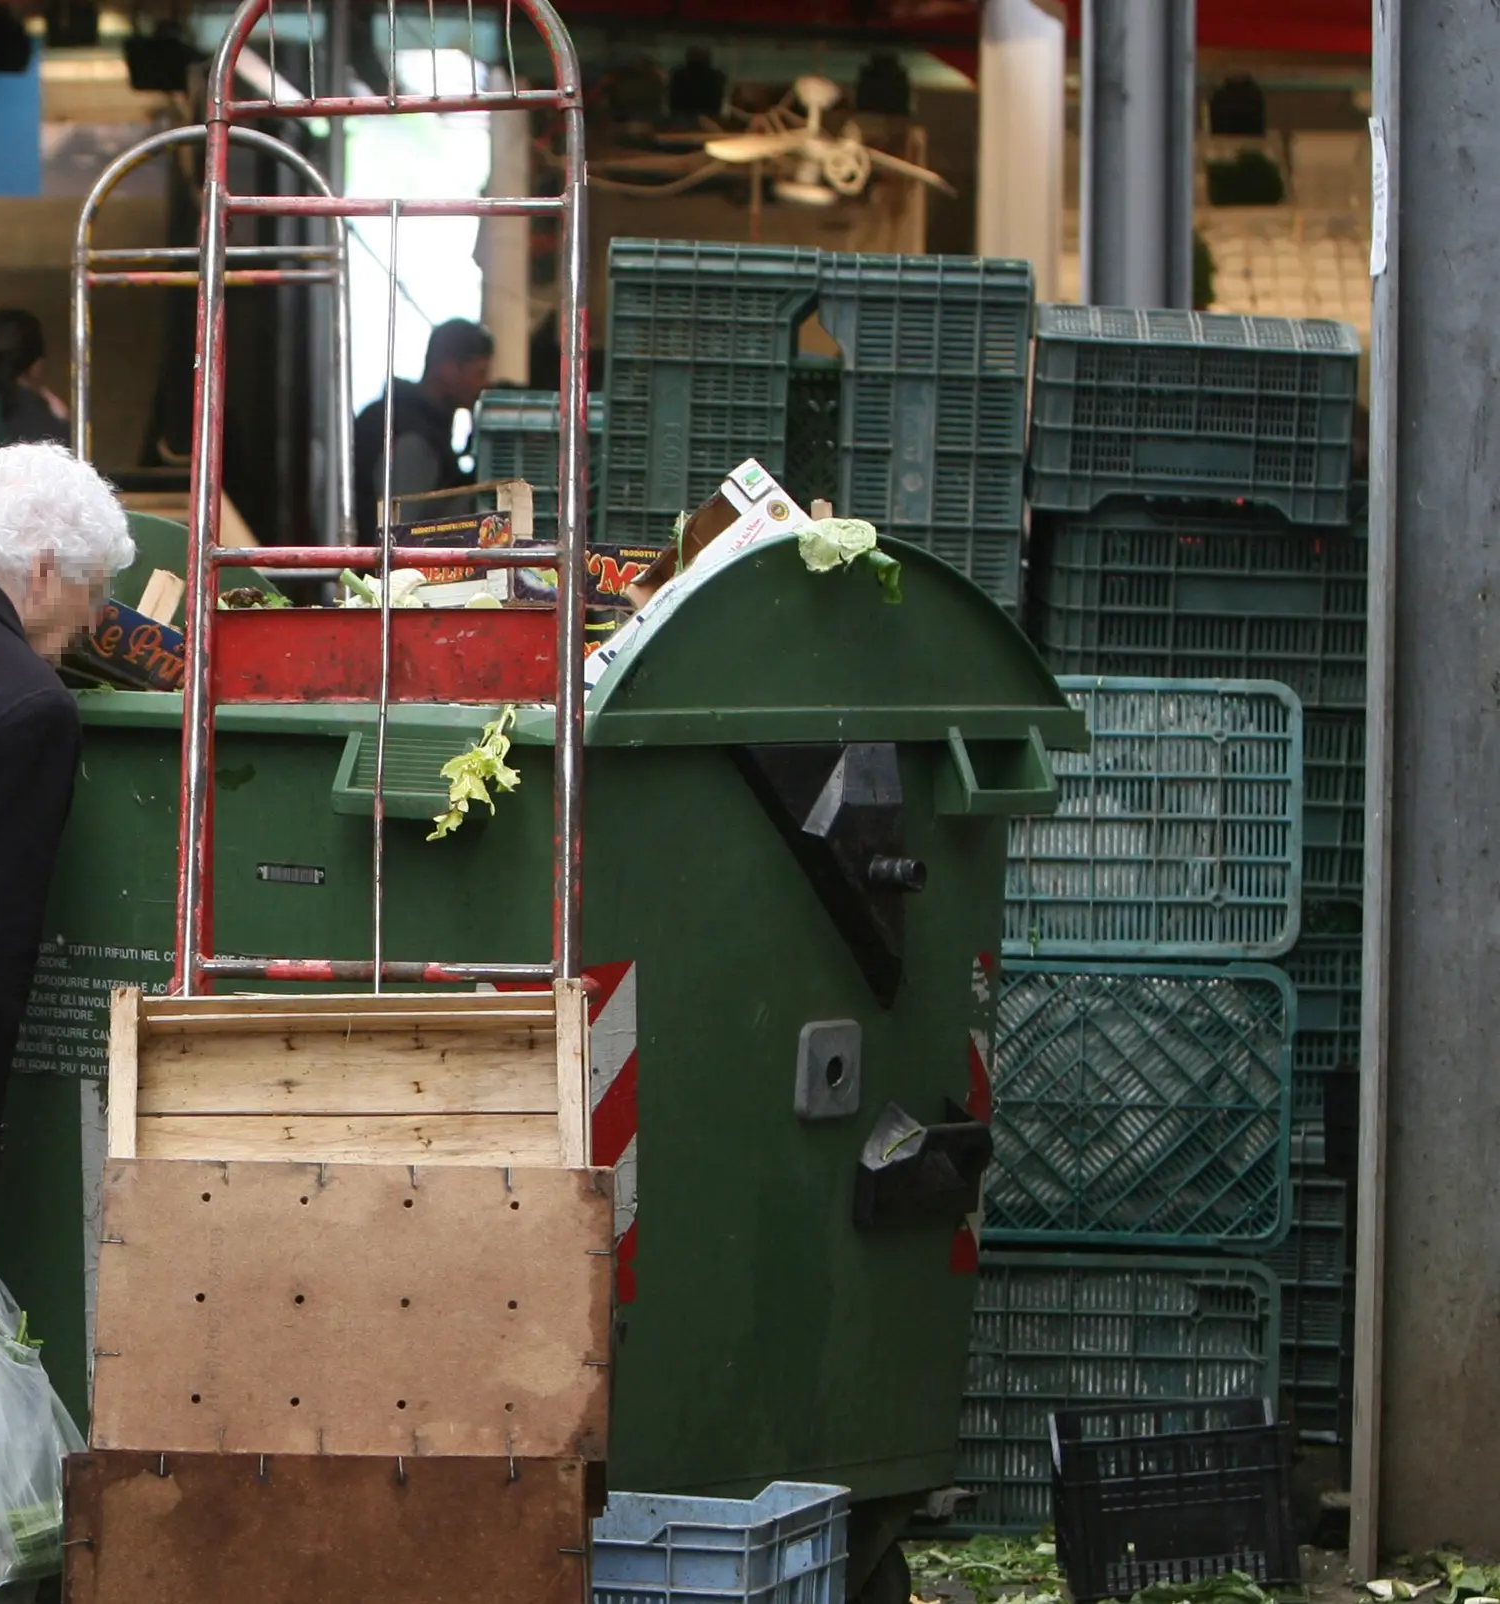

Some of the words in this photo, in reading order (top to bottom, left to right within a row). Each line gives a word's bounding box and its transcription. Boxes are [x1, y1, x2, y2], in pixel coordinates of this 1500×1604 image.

[619, 549, 656, 558] PRODOTTI
[68, 944, 97, 957] TUTTI
[104, 947, 138, 960] RIFIUTI
[140, 949, 161, 962] NEL
[80, 1063, 110, 1076] PULIT
